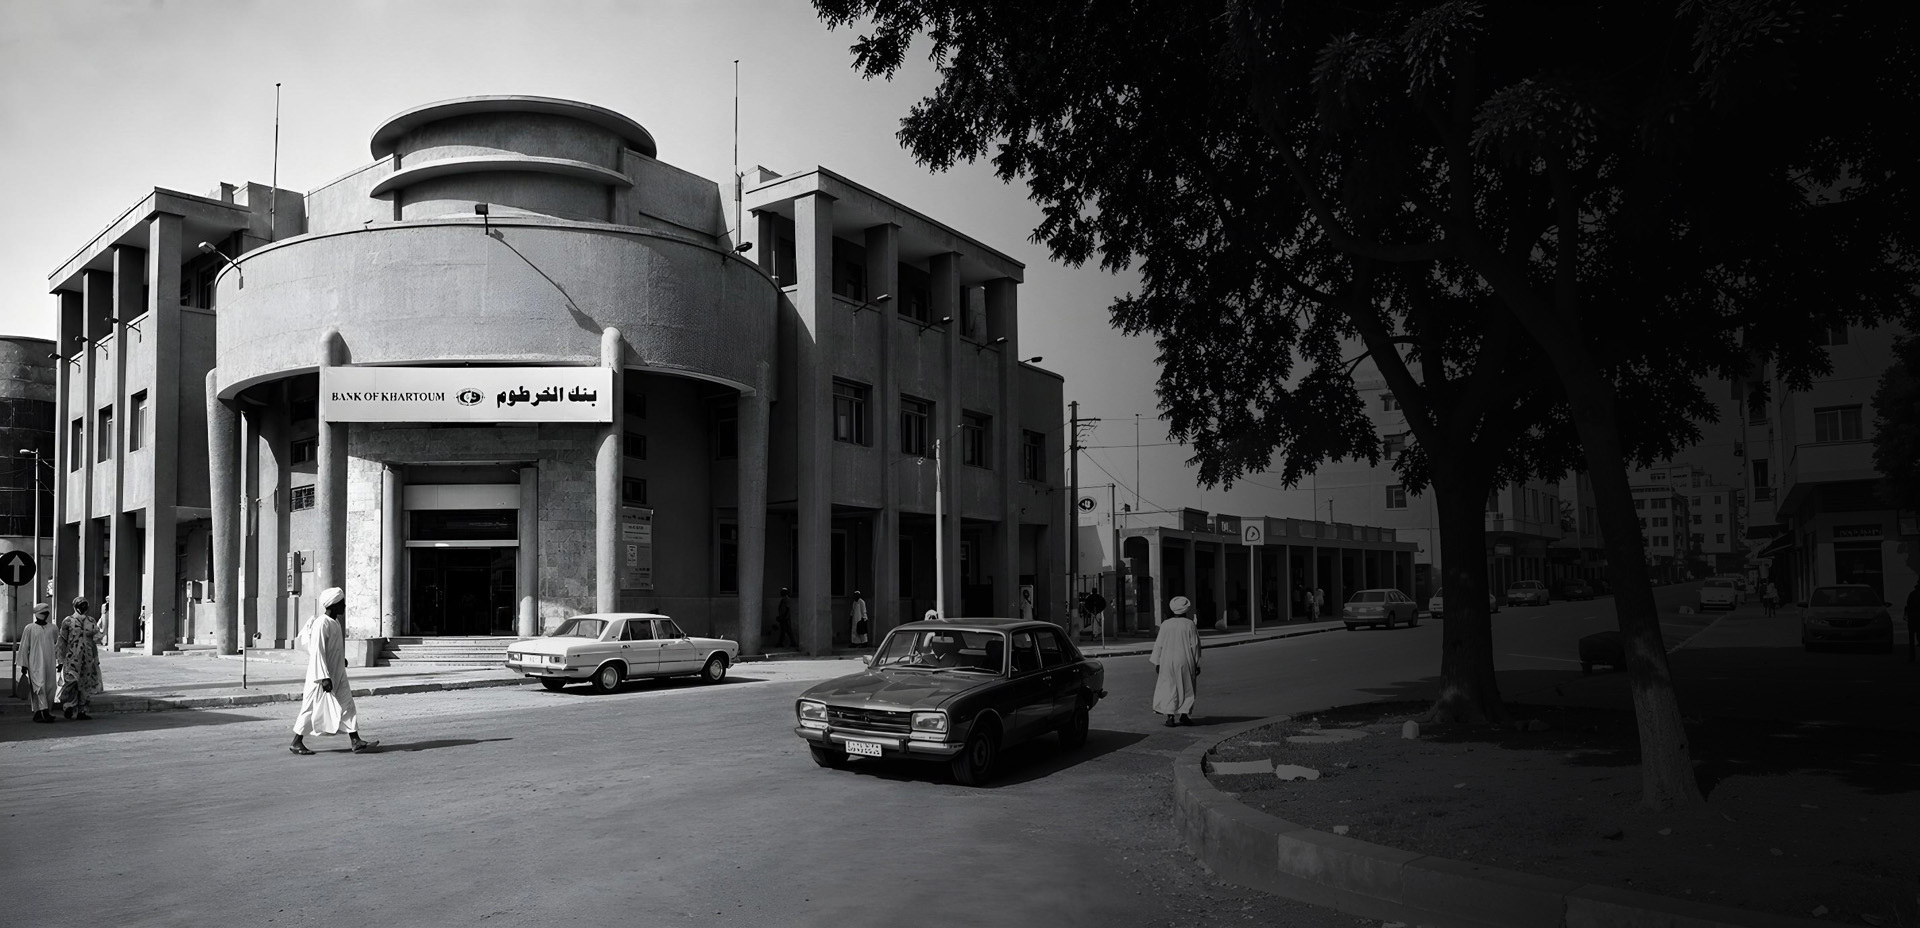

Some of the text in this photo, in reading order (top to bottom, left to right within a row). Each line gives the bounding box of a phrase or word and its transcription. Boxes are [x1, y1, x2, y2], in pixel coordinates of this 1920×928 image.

[332, 392, 445, 401] BANK OF KHARTOUM
[496, 385, 597, 408] بنك الخرطوم
